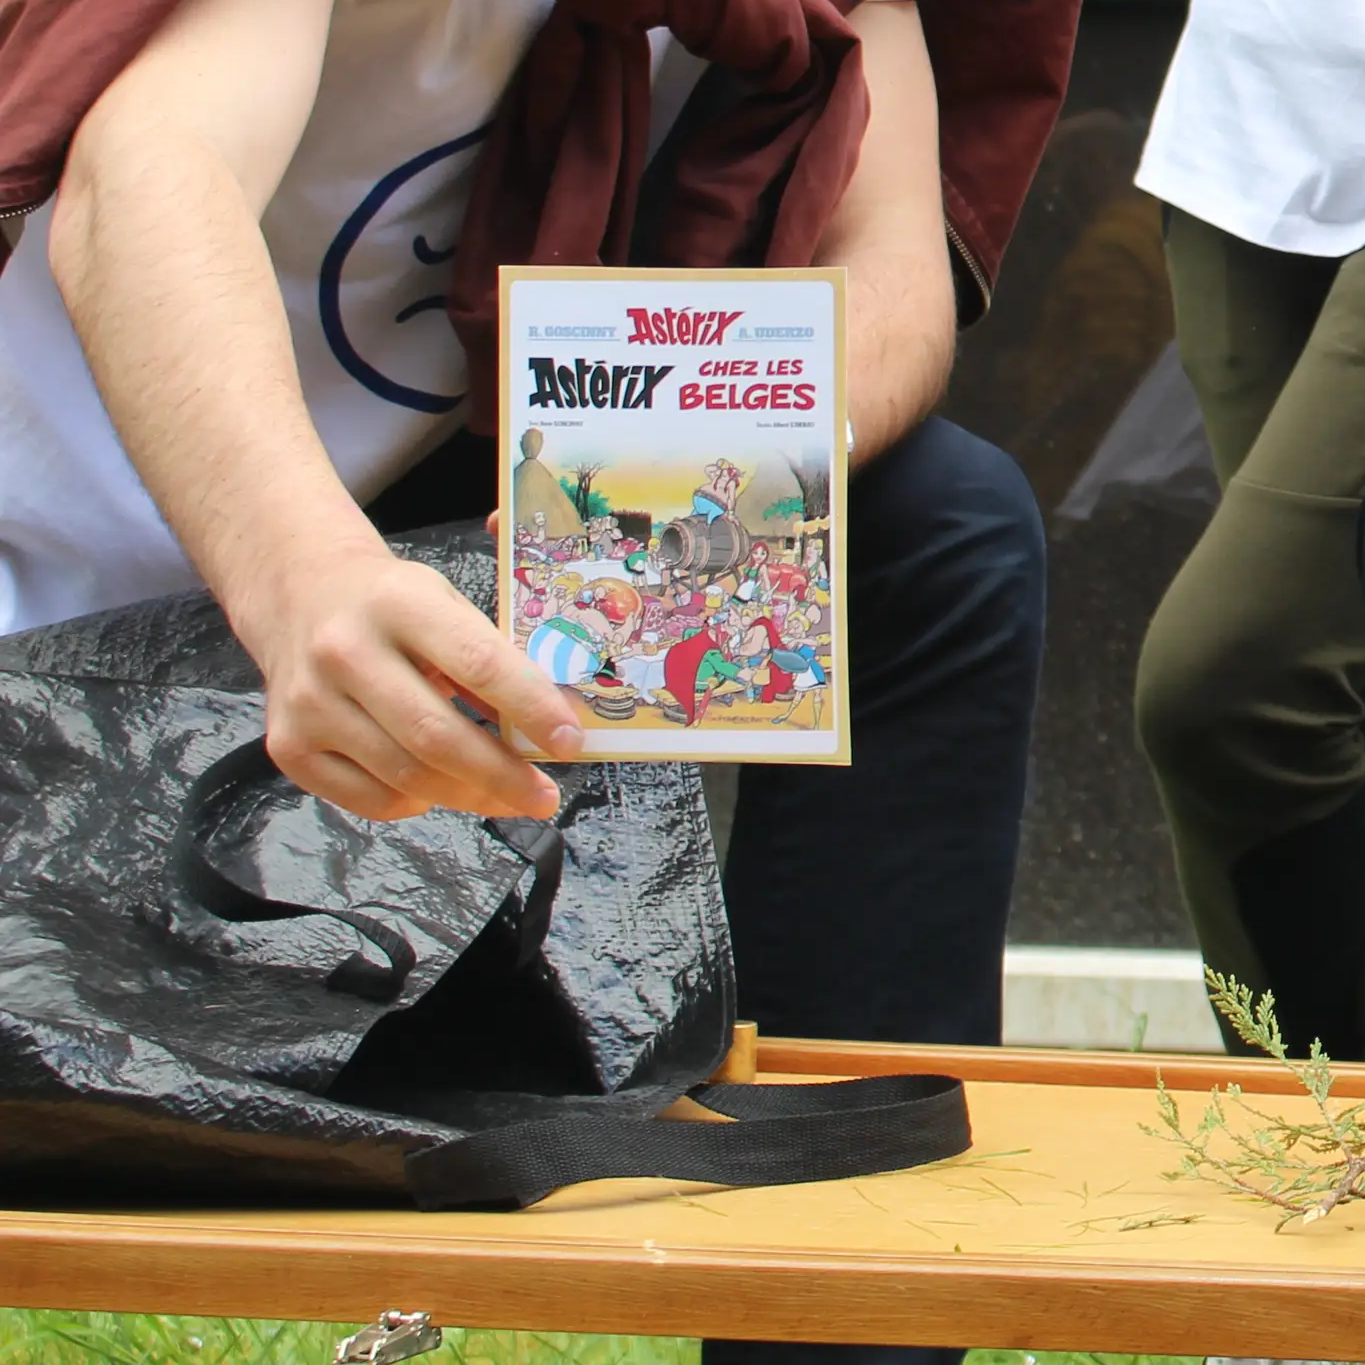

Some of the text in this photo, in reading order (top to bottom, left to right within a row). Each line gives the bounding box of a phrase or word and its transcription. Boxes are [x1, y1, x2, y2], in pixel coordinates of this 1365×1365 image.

[626, 306, 746, 346] Astérix
[528, 357, 676, 410] Astérix
[698, 359, 804, 377] CHEZ LES
[679, 382, 817, 411] BELGES
